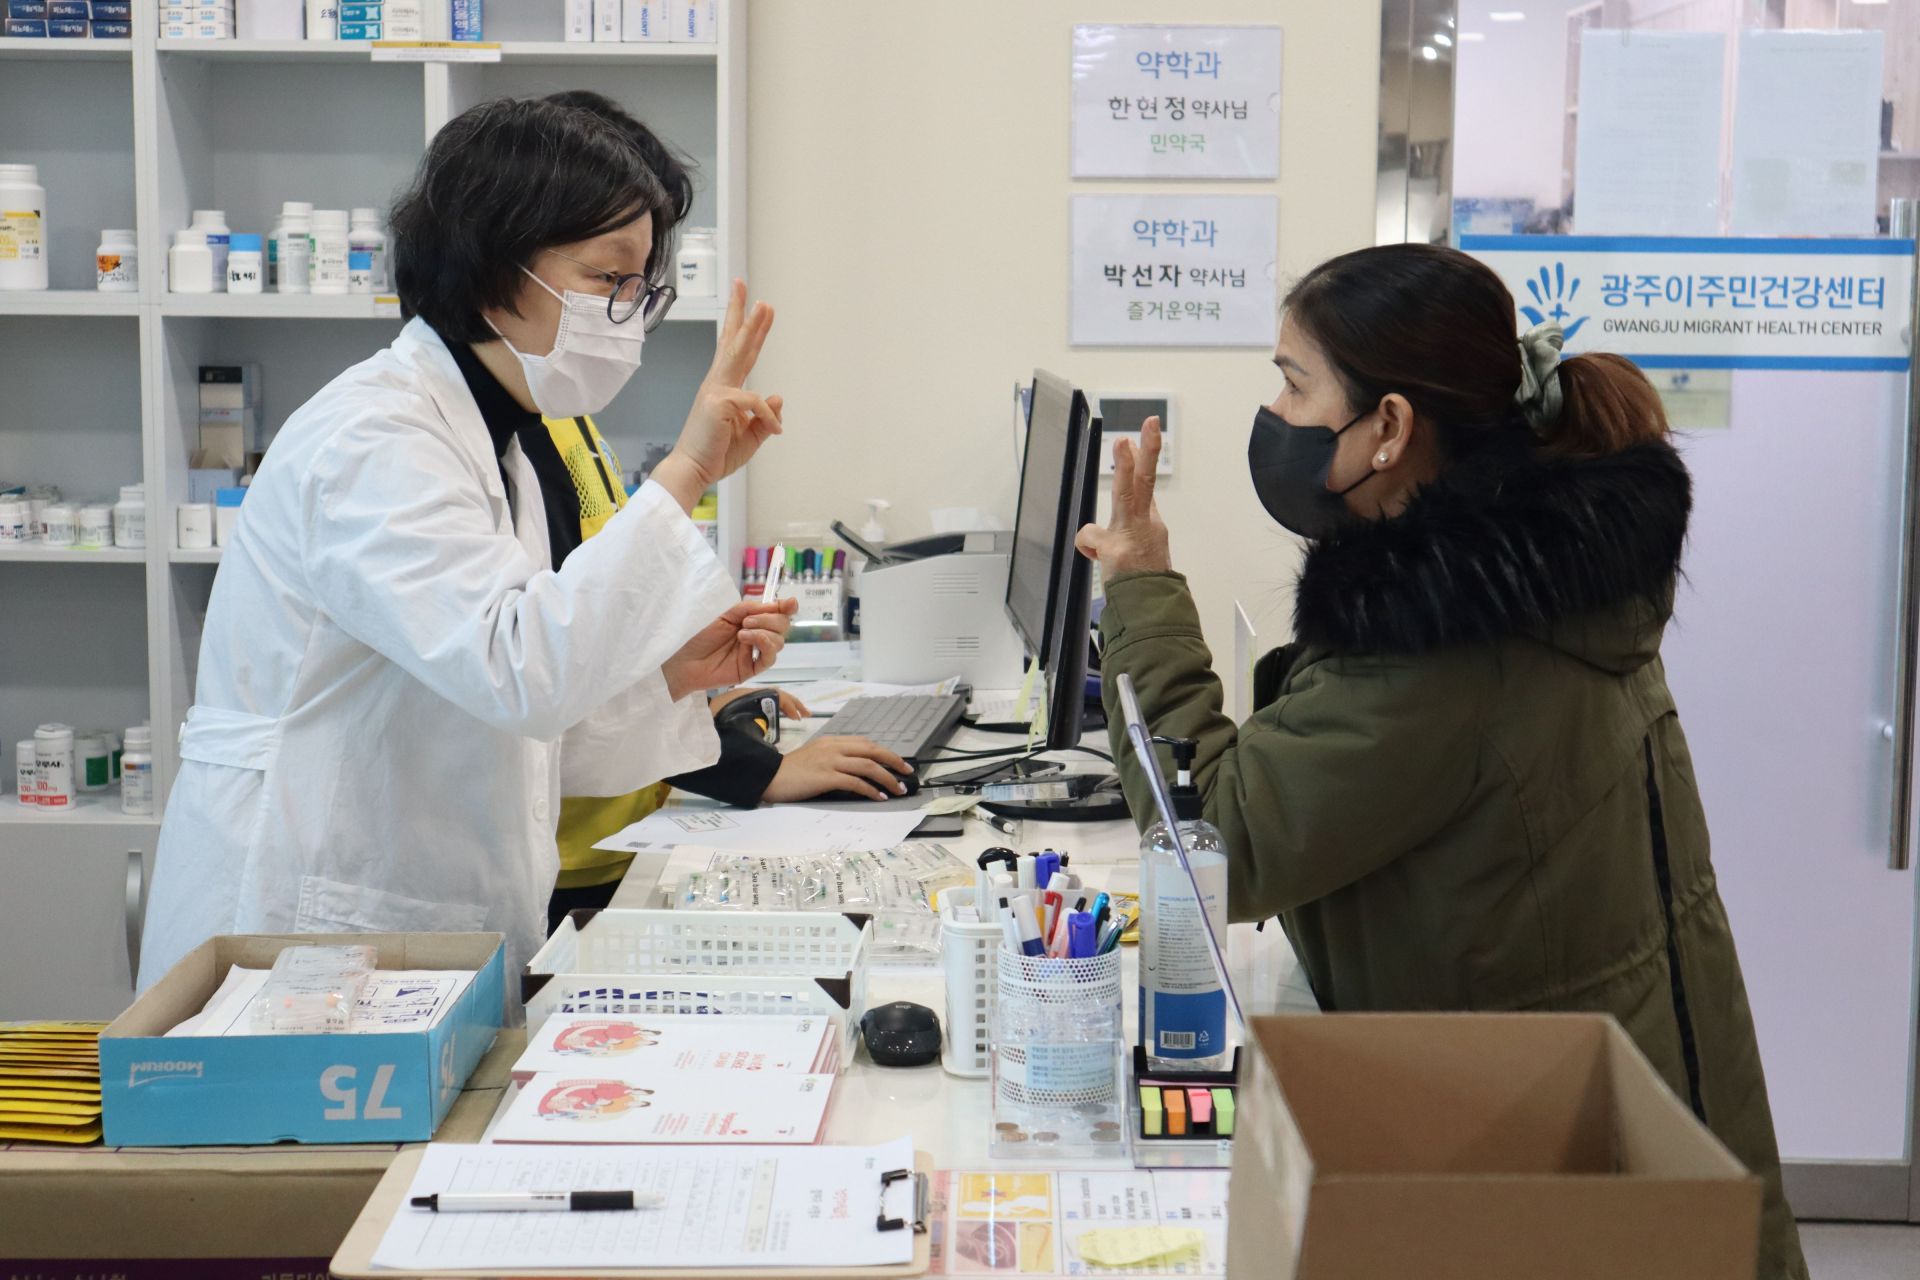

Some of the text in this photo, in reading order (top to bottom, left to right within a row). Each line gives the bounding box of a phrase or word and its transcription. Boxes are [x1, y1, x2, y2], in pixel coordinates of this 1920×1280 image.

[1136, 50, 1222, 79] 약학과
[1191, 99, 1248, 120] 약사님
[1150, 133, 1206, 152] 민약국
[1132, 219, 1218, 248] 약학과
[1189, 267, 1246, 288] 약사님
[1600, 274, 1885, 310] 광주이주민건강센터
[1127, 301, 1221, 321] 즐거운약국
[1603, 319, 1883, 335] GWANGJU MIGRANT HEALTH CENTER
[130, 1061, 203, 1075] MOORIM
[319, 1064, 402, 1120] 75
